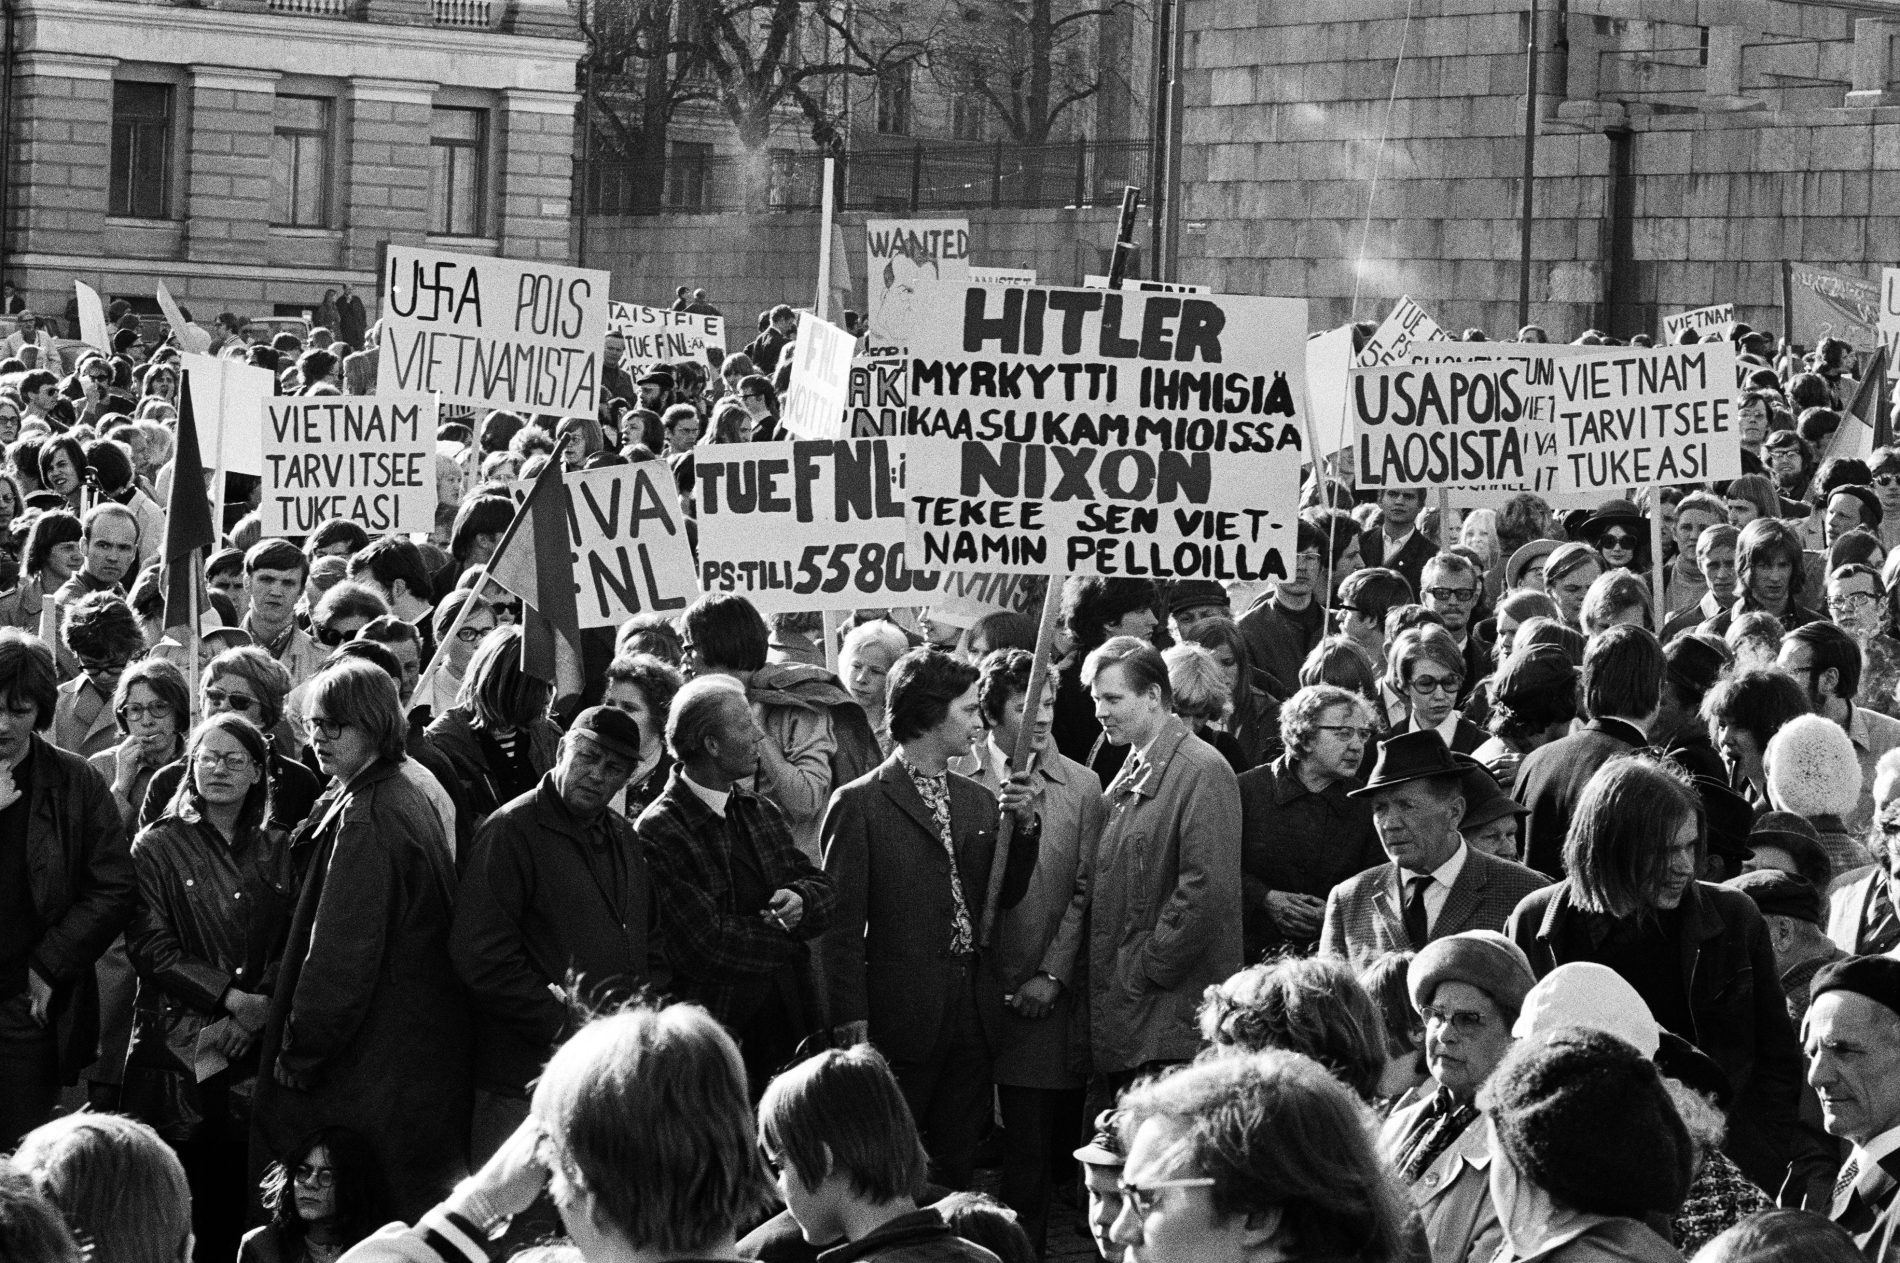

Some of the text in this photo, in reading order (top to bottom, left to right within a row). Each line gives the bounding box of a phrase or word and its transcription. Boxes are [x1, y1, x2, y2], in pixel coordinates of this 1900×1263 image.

[868, 227, 969, 259] WANTED
[514, 273, 591, 339] POIS
[963, 287, 1226, 364] HITLER
[1394, 296, 1427, 337] TUE
[1667, 307, 1734, 334] VIETNAM
[388, 327, 595, 412] VIETNAMISTA
[625, 334, 652, 358] TUE
[912, 359, 1296, 418] MYRKYTTI IHMISIÄ
[1558, 352, 1706, 401] VIETNAM
[269, 404, 418, 443] VIETNAM
[1560, 399, 1729, 446] TARVITSEE
[265, 452, 426, 488] TARVITSEE
[960, 440, 1212, 504] NIXON
[1361, 426, 1523, 486] LAOSISTA
[1567, 443, 1708, 487] TUKEASI
[276, 494, 399, 531] TUKEASI
[515, 469, 677, 547] IVA
[912, 497, 1045, 531] TEKEE
[1077, 503, 1159, 534] SEN
[923, 531, 1288, 581] NAMIN PELLOILLA
[571, 543, 686, 618] NL
